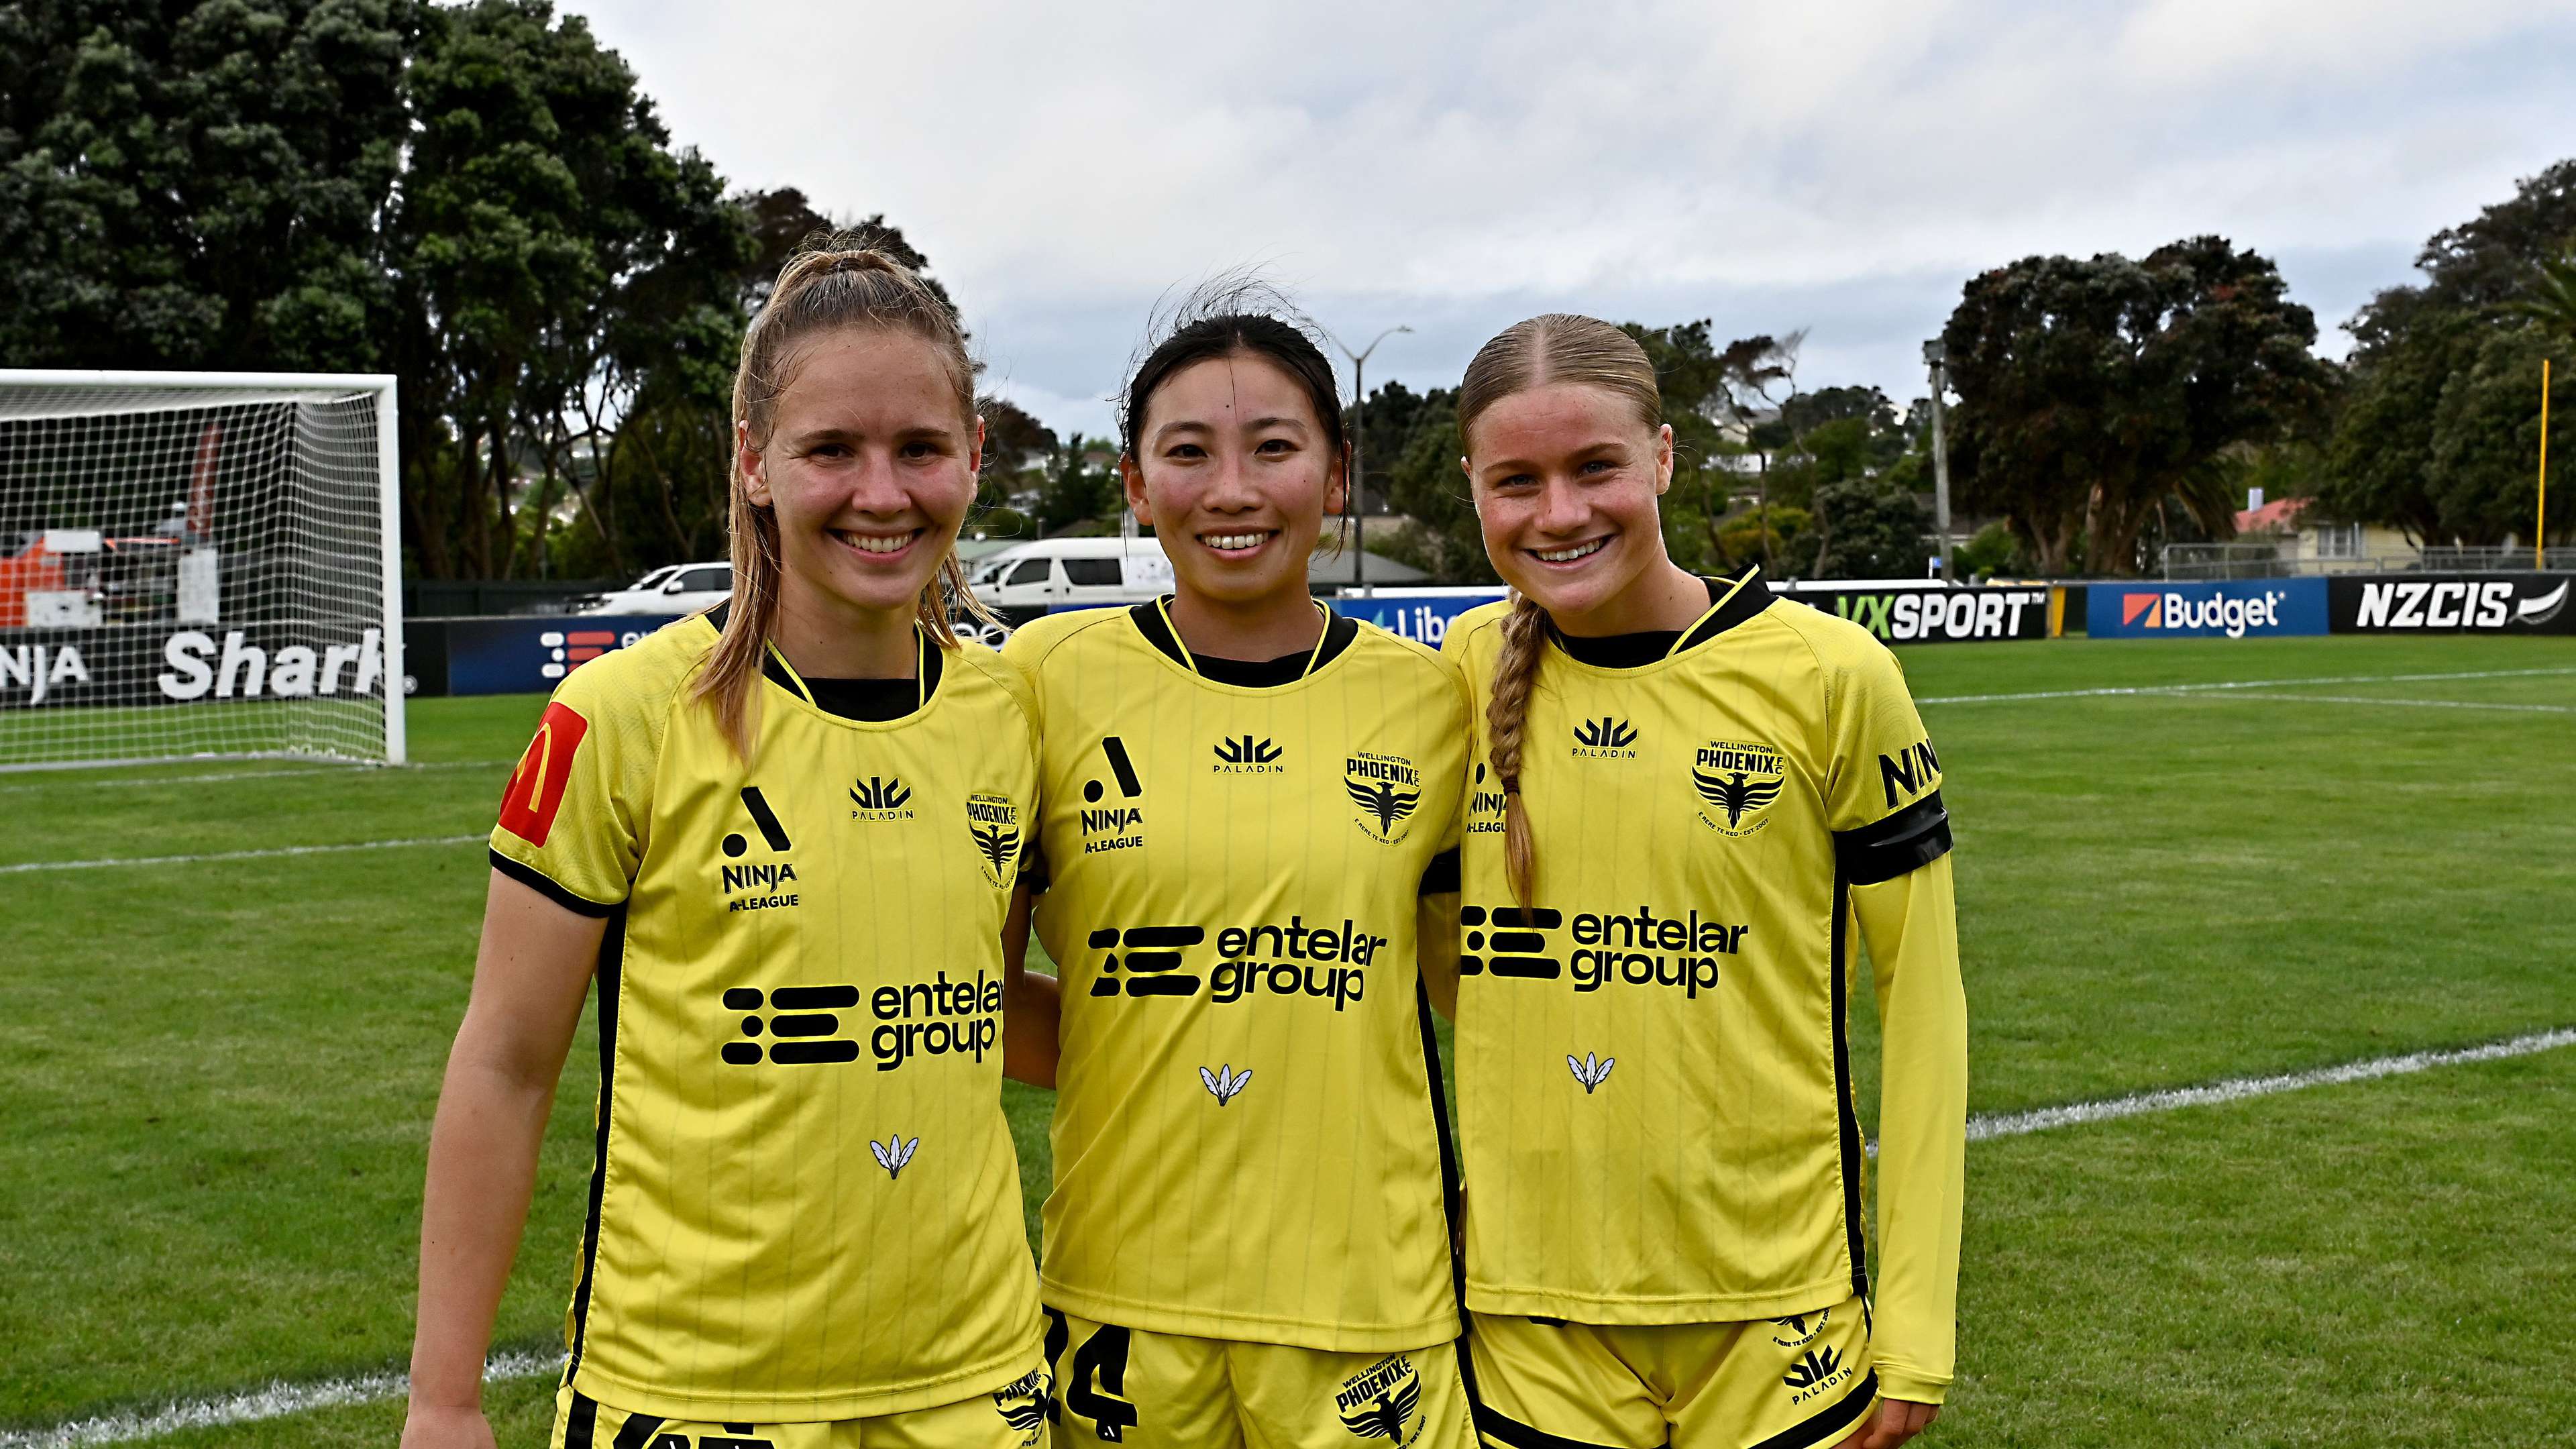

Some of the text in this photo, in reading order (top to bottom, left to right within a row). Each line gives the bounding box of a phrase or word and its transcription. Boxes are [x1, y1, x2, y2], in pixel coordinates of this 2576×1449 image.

[2164, 591, 2279, 638] Budget
[2356, 582, 2514, 627] NZCIS
[1357, 751, 1411, 766] WELLINGTON
[1572, 748, 1635, 759] PALADIN
[1696, 748, 1775, 773] PHOENIX
[1710, 741, 1773, 753] WELLINGTON
[1214, 765, 1283, 773] PALADIN
[1346, 758, 1413, 786] PHOENIX
[966, 802, 1011, 825] PHOENIX
[971, 794, 1008, 805] WELLINGTON
[1469, 792, 1507, 820] NINJ
[852, 810, 914, 820] PALADIN
[1081, 808, 1143, 836] NINJA
[1466, 822, 1506, 833] A-LEAG
[1756, 818, 1769, 830] 2007
[1085, 836, 1143, 854] A-LEAGUE
[722, 863, 798, 894] NINJA
[729, 894, 799, 912] A-LEAGUE
[1217, 916, 1387, 966] entelar
[1572, 906, 1749, 954] entelar
[1210, 961, 1364, 1012] group
[1570, 949, 1718, 999] group
[871, 969, 1004, 1020] entela
[871, 1017, 996, 1071] group
[1342, 1352, 1396, 1389] WELLINGTON
[1335, 1358, 1407, 1413] PHOENIX
[1792, 1366, 1852, 1405] PALADIN
